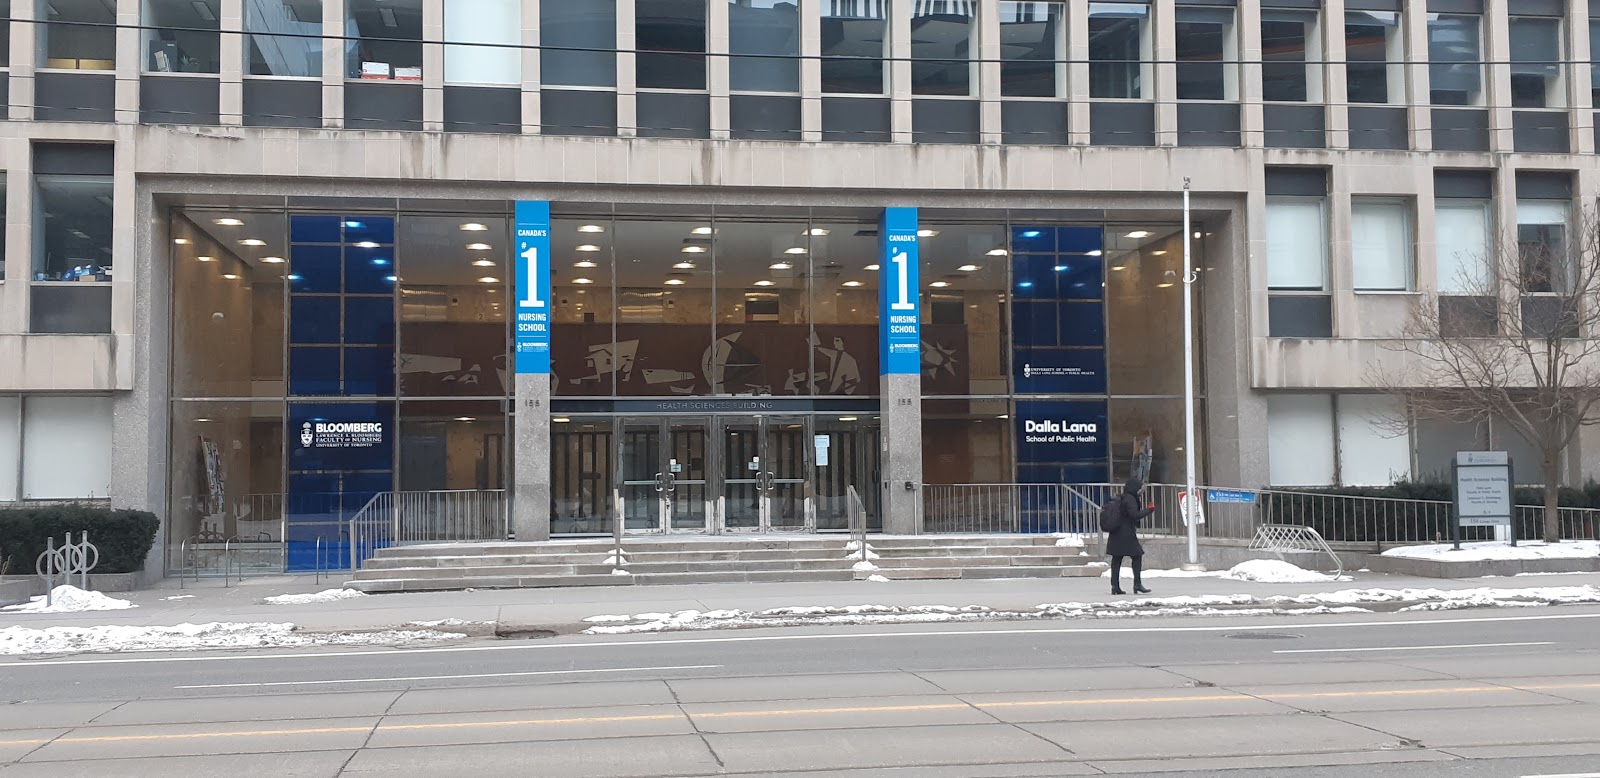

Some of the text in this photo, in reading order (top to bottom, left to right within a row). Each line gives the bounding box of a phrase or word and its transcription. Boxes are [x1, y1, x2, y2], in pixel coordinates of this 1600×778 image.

[518, 313, 546, 321] NURSING
[316, 422, 382, 432] BLOOMBERG
[1025, 420, 1096, 432] Dalla Lana
